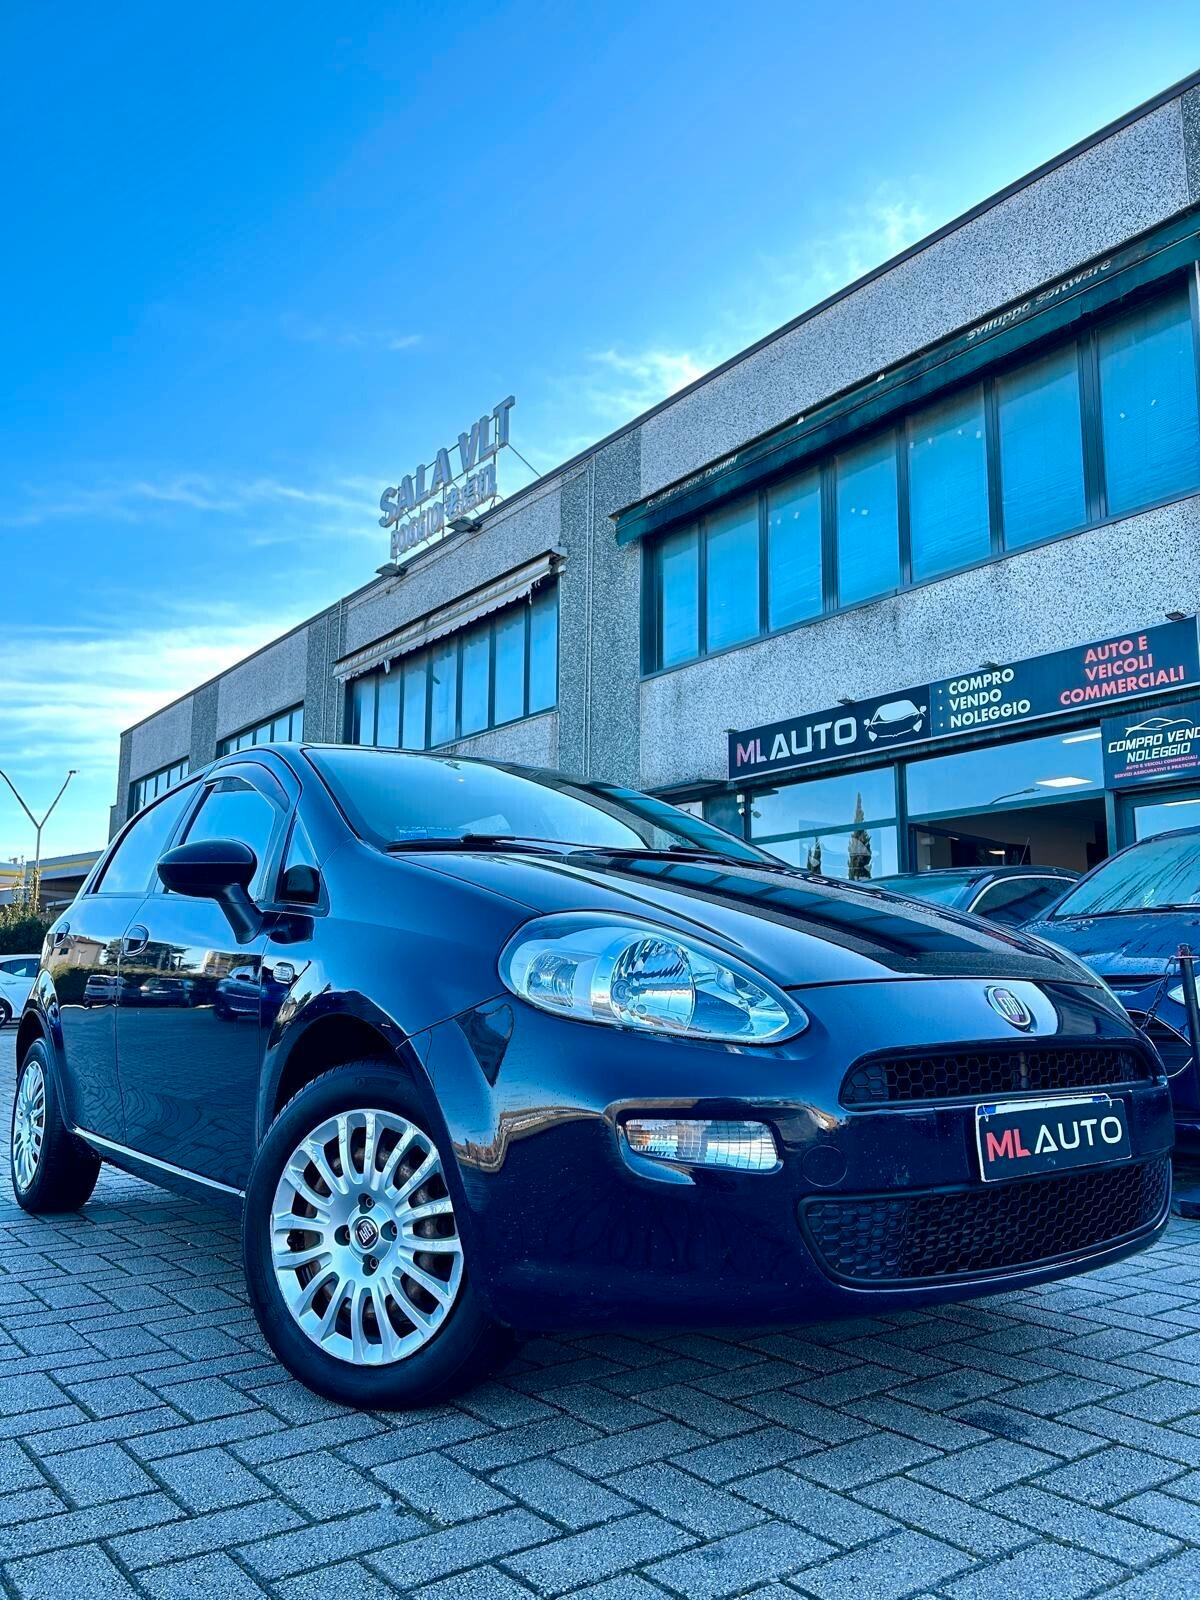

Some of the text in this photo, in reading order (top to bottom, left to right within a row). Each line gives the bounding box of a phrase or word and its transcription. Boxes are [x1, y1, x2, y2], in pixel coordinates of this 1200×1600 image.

[965, 301, 1031, 342] Sviluppo
[379, 447, 452, 528] SALA
[458, 395, 515, 473] VLT
[1085, 635, 1148, 664] AUTO E
[1085, 653, 1153, 681] VEICOLI
[949, 668, 1015, 695] COMPRO
[1060, 665, 1185, 705] COMMERCIALI
[949, 688, 1002, 712] VENDO
[950, 699, 1031, 729] NOLEGGIO
[1108, 733, 1163, 753] COMPRO
[1126, 742, 1191, 763] NOLEGGIO
[1144, 760, 1162, 768] VEICOLI
[1163, 755, 1198, 764] COMMERCIALI
[999, 995, 1024, 1016] FIAT
